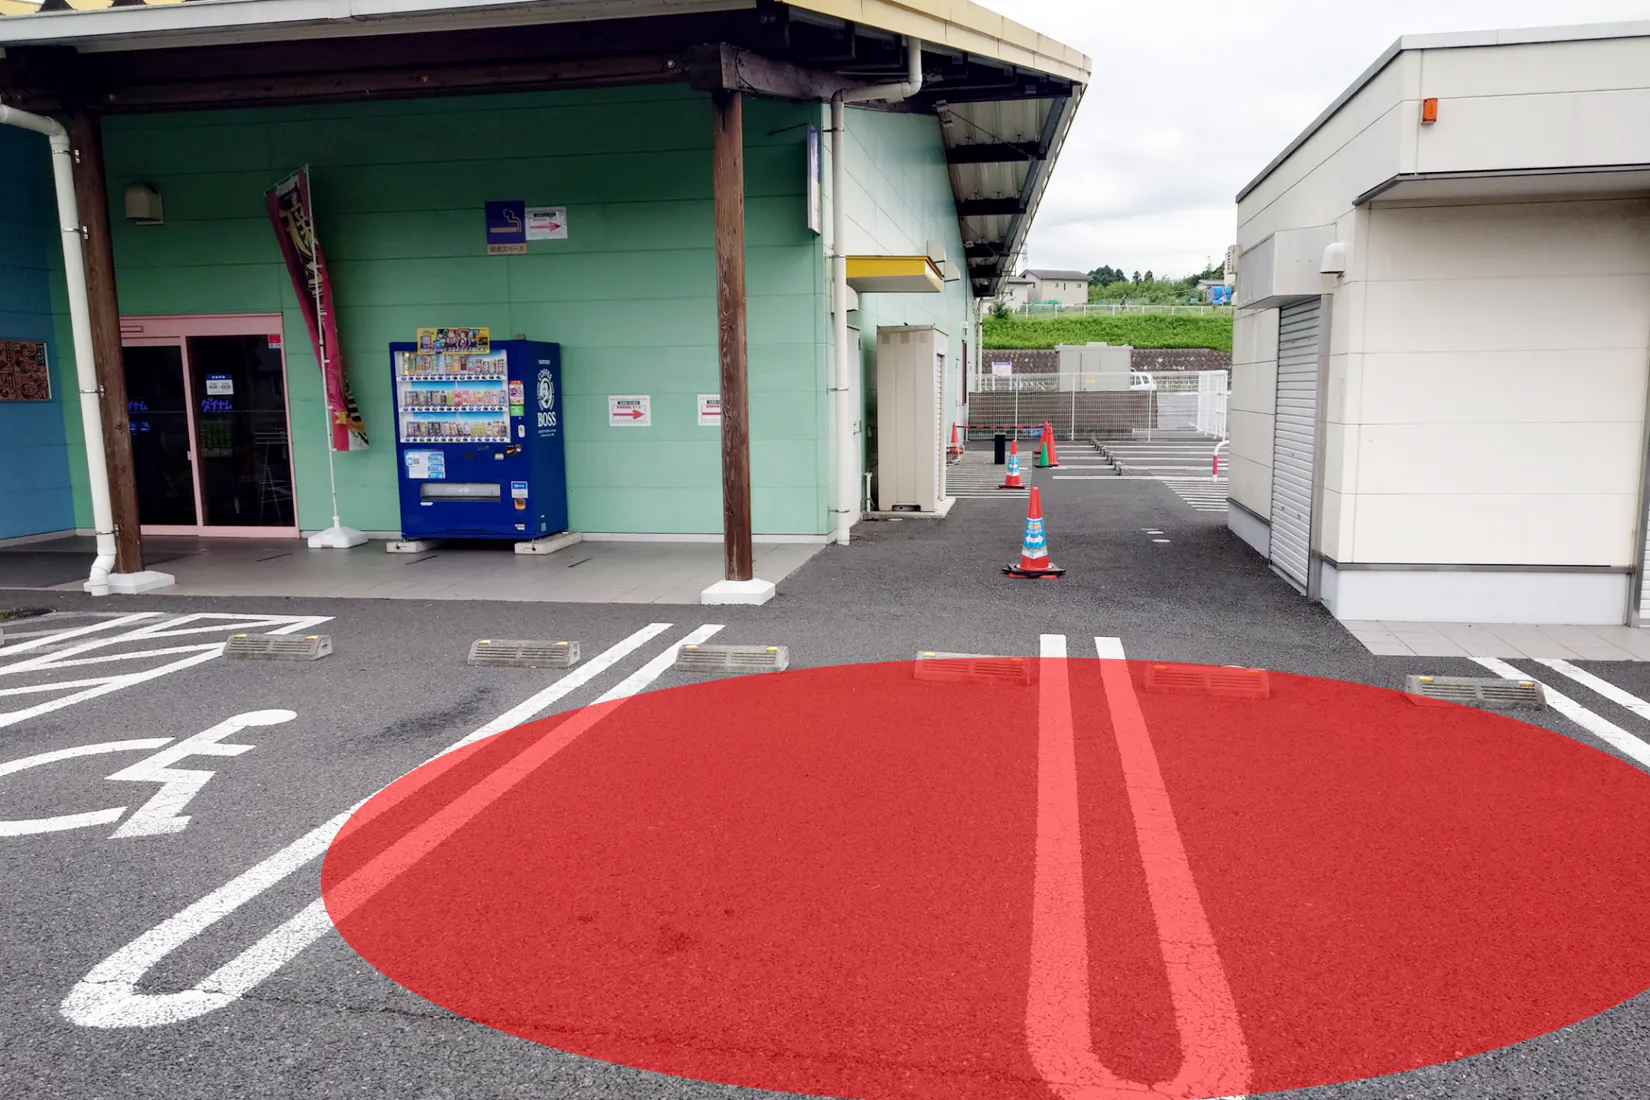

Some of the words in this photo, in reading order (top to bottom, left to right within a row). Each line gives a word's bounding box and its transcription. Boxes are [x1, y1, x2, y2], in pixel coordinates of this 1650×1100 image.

[127, 400, 148, 411] イナム
[201, 397, 233, 413] ダイナム
[537, 411, 557, 428] BOSS
